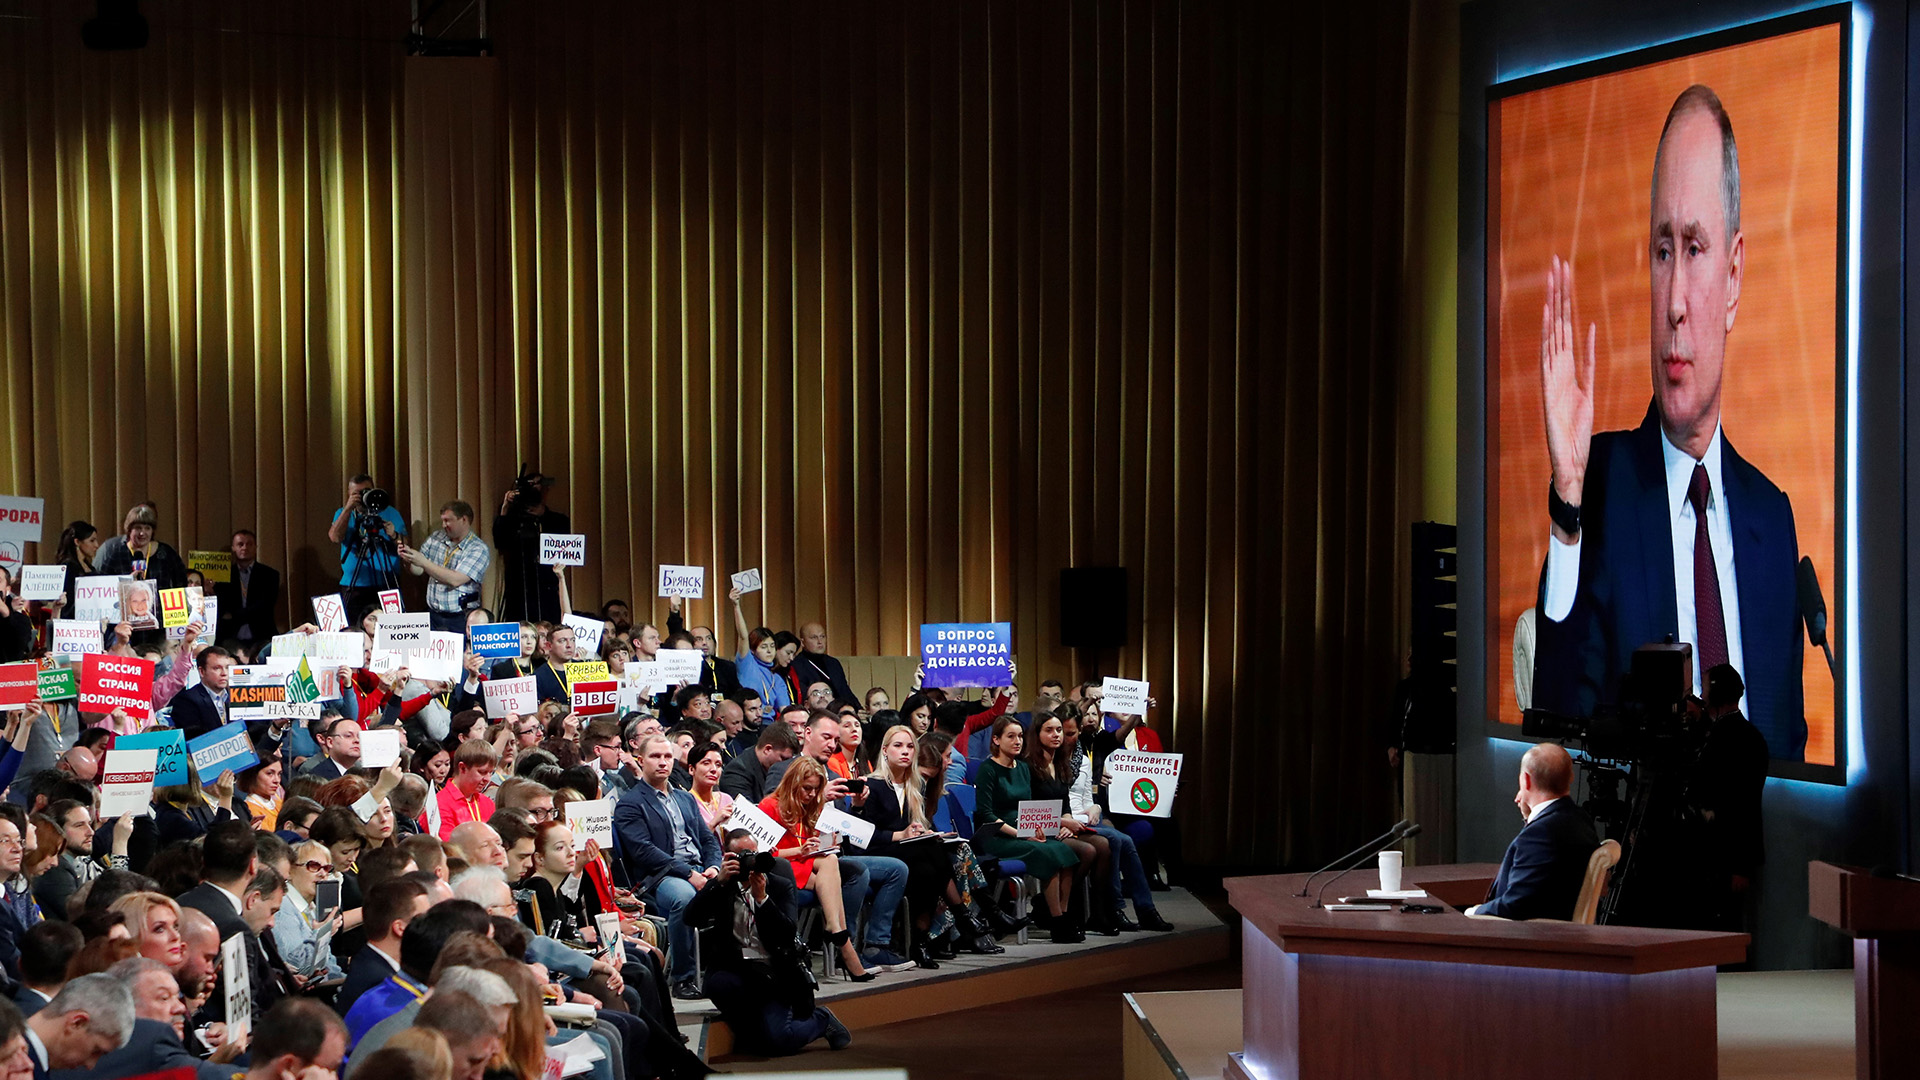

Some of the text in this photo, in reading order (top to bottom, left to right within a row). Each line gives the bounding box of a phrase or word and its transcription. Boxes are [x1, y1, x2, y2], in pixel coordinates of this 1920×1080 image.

[544, 539, 582, 548] ПОДАРОК
[544, 550, 581, 560] ПУТИНА
[24, 571, 64, 580] Памятник
[734, 570, 760, 592] SOS
[24, 581, 62, 592] АЛЁШКЕ
[162, 590, 184, 611] Ш
[379, 622, 430, 630] Уссурийский
[55, 629, 100, 638] МАТЕРИ
[473, 632, 519, 643] НОВОСТИ
[937, 630, 995, 640] ВОПРОС
[473, 642, 519, 651] ТРАНСПОРТА
[925, 643, 1007, 654] ОТ НАРОДА
[98, 661, 142, 675] РОССИЯ
[927, 656, 1006, 669] ДОНБАССА
[98, 678, 139, 692] СТРАНА
[485, 681, 534, 697] ЦИФРОВОЕ
[1109, 684, 1138, 693] ПЕНСИИ
[230, 686, 285, 702] KASHMIR
[80, 693, 150, 710] ВОЛОНТЕРОВ
[500, 698, 519, 710] ТВ
[268, 704, 316, 717] НАУКА
[194, 734, 248, 768] БЕЛГОРОД
[1114, 754, 1172, 766] ОСТАНОВИТЕ
[1114, 764, 1172, 776] ЗЕЛЕНСКОГО
[586, 816, 608, 824] Живая
[586, 824, 611, 834] Кубань
[731, 807, 776, 846] МАГАДАН
